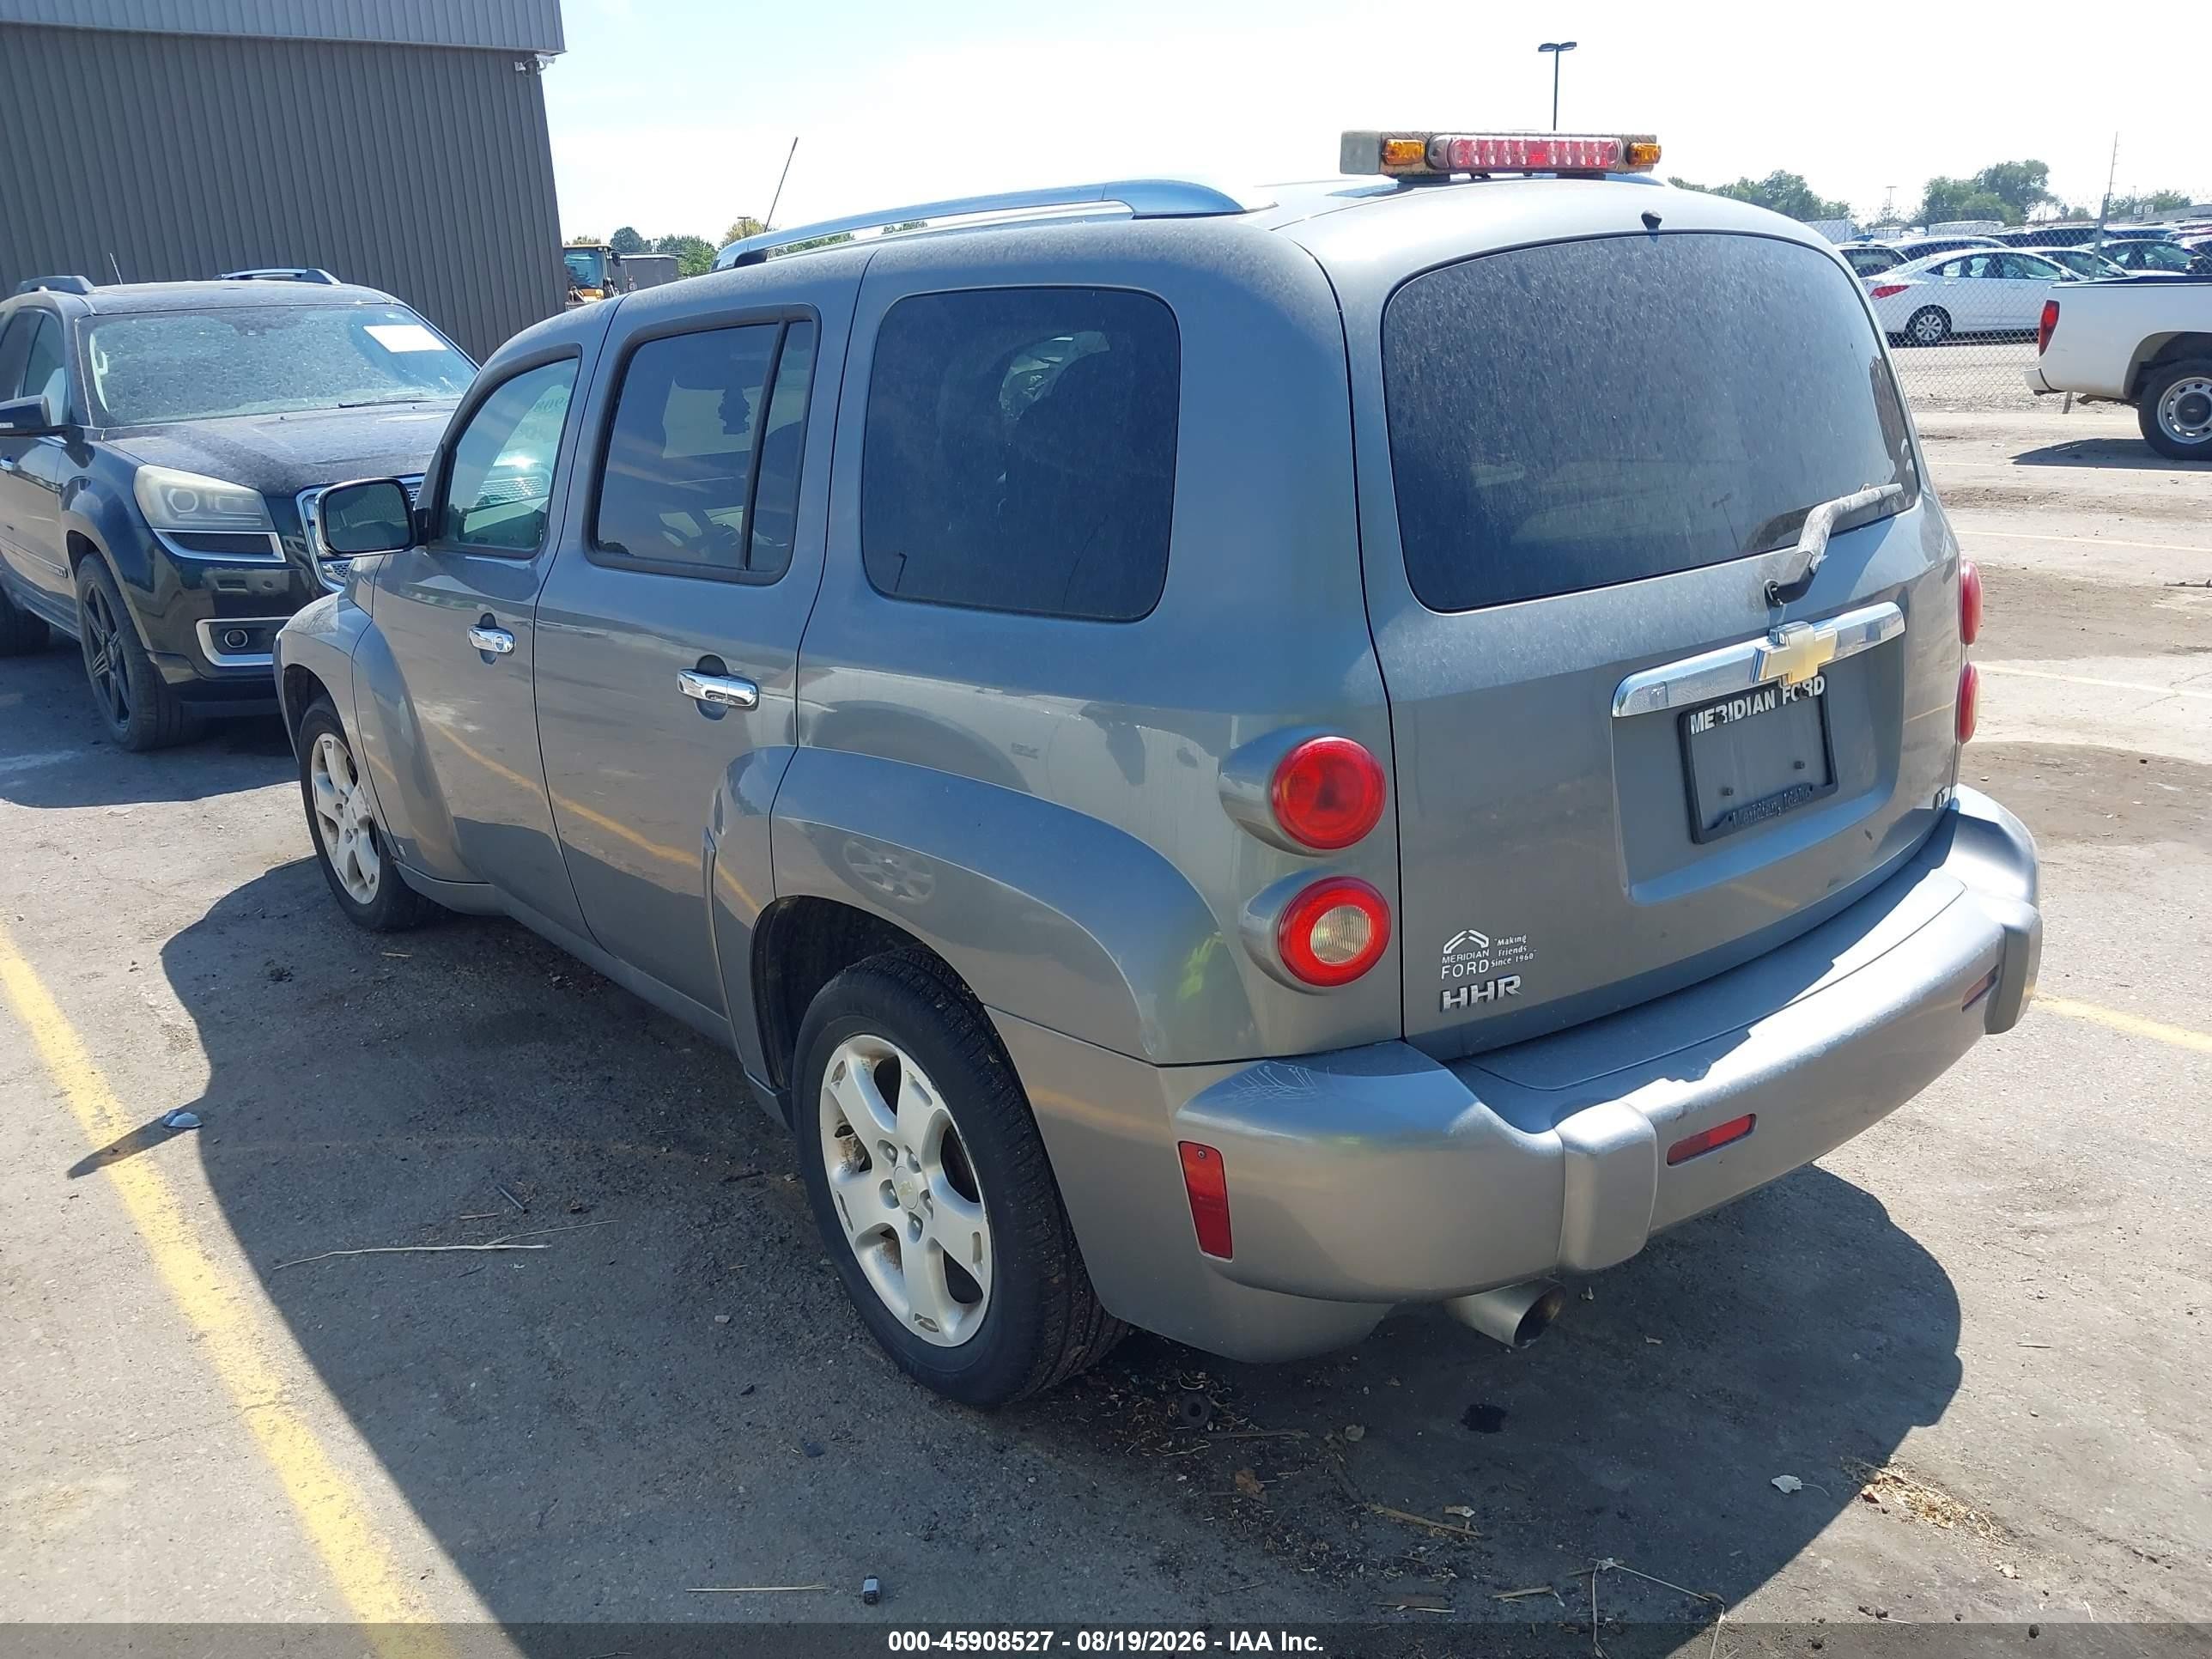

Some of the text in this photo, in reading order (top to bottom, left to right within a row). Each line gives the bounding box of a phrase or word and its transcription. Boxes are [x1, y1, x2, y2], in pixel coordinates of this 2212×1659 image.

[1690, 690, 1776, 735] MERIDIAN
[1442, 948, 1490, 963] MERIDIAN
[1498, 945, 1527, 957] Friends
[1442, 959, 1490, 980] FORD
[1491, 957, 1512, 968] Since
[1442, 975, 1522, 1011] HHR
